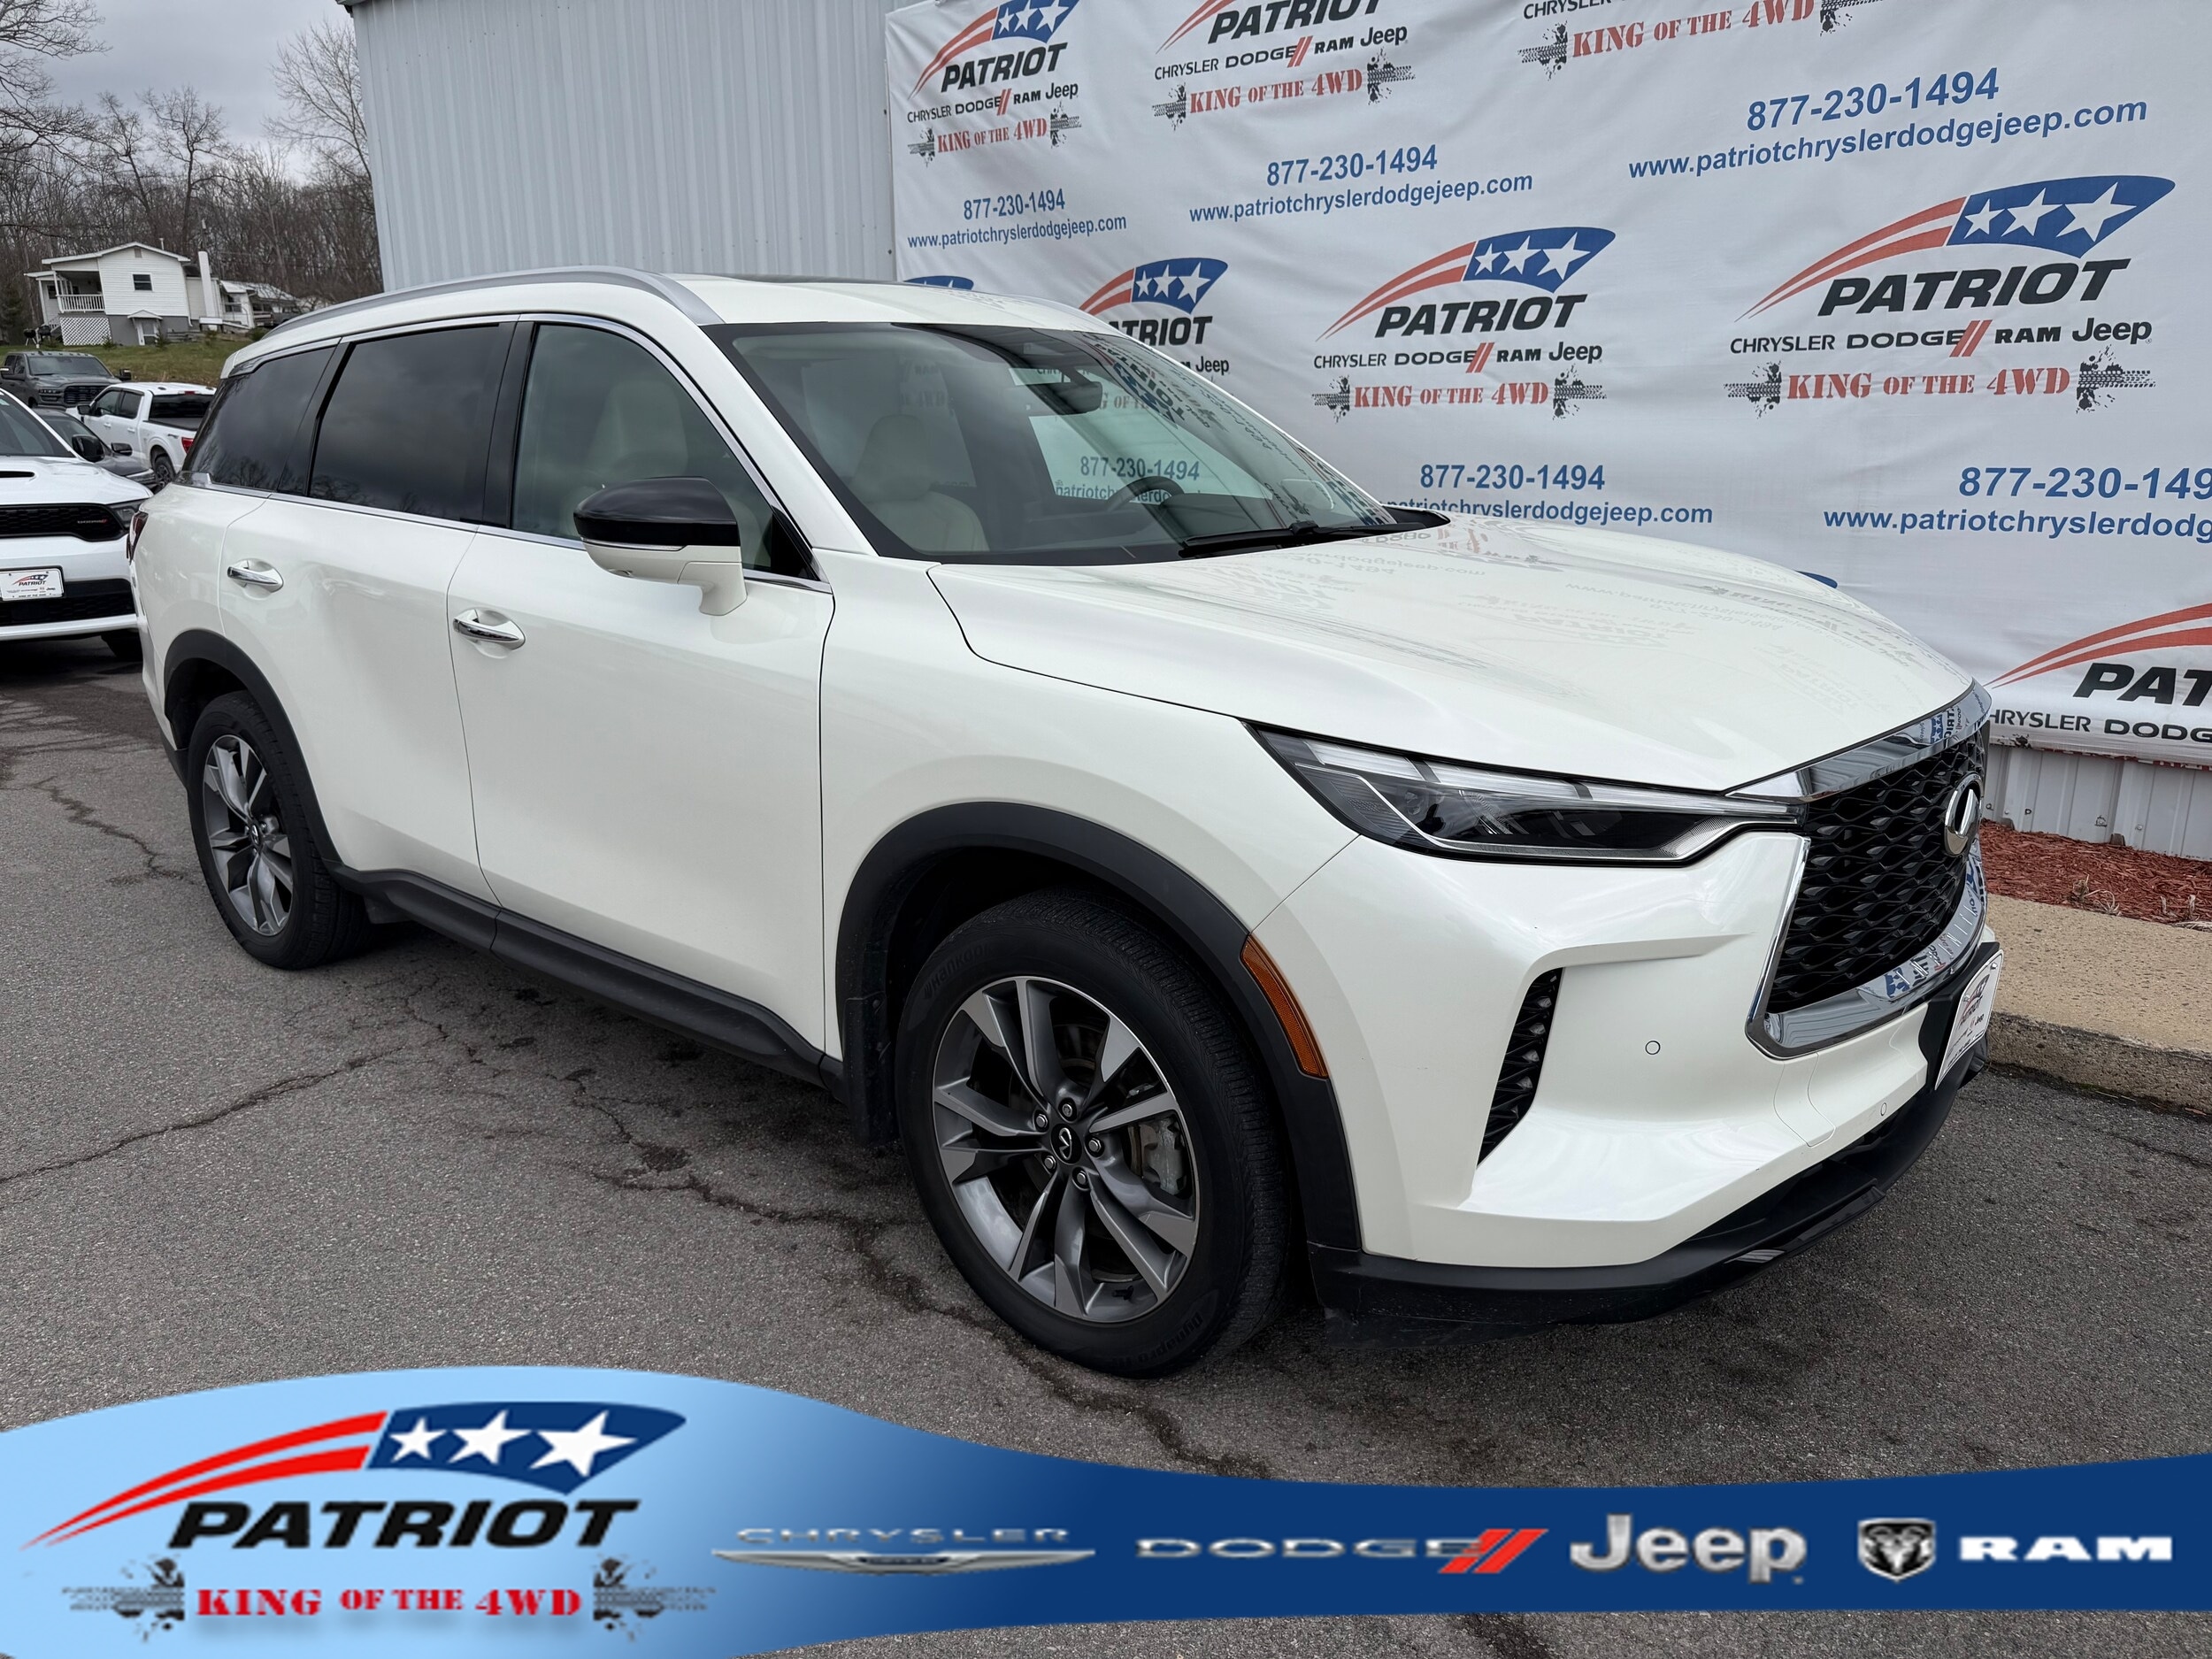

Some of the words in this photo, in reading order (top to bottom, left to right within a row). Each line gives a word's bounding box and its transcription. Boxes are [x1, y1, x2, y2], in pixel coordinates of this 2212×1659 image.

[1524, 0, 1611, 19] CHRYSL
[1572, 20, 1644, 58] KING
[1654, 19, 1681, 42] OF
[1686, 11, 1732, 37] THE
[1742, 0, 1814, 27] 4WD
[941, 42, 1068, 93] PATRIOT
[1154, 58, 1219, 81] CHRYSLER
[1225, 44, 1297, 69] DODGE
[1314, 36, 1354, 55] RAM
[1360, 25, 1408, 47] Jeep
[907, 105, 952, 124] CHRYSLER
[956, 96, 1002, 115] DODGE
[1013, 89, 1041, 105] RAM
[1045, 82, 1079, 100] Jeep
[1189, 86, 1240, 114] KING
[1248, 85, 1268, 104] OF
[1271, 80, 1304, 99] THE
[1310, 68, 1363, 96] 4WD
[1747, 66, 2000, 132] 877-230-1494
[937, 131, 972, 153] KING
[974, 132, 988, 147] OF
[988, 127, 1010, 142] THE
[1014, 118, 1048, 141] 4WD
[1628, 97, 2148, 178] www.patriotchryslerdodgejeep.com
[1267, 143, 1438, 187] 877-230-1494
[964, 188, 1066, 219] 877-230-1494
[1189, 174, 1533, 223] www.patriotchryslerdodgejeep.com
[907, 214, 1126, 250] www.patriotchryslerdodgejeep.com
[1817, 258, 2131, 317] PATRIOT
[1109, 316, 1213, 346] TRIOT
[1374, 294, 1588, 339] PATRIOT
[1730, 334, 1835, 354] CHRYSLER
[1846, 329, 1964, 349] DODGE
[1994, 326, 2062, 345] RAM
[2072, 318, 2152, 345] Jeep
[1195, 356, 1230, 375] Jeep
[1313, 353, 1386, 370] CHRYSLER
[1394, 349, 1475, 366] DODGE
[1496, 348, 1541, 363] RAM
[1548, 341, 1602, 364] Jeep
[1354, 385, 1412, 408] KING
[1420, 387, 1443, 405] OF
[1447, 386, 1484, 403] THE
[1491, 381, 1548, 405] 4WD
[1787, 372, 1871, 400] KING
[1883, 375, 1916, 396] OF
[1921, 373, 1975, 395] THE
[1986, 367, 2070, 396] 4WD
[1080, 456, 1200, 481] 877-230-1494
[1420, 464, 1605, 490] 877-230-1494
[1990, 709, 2091, 733] HRYSLER
